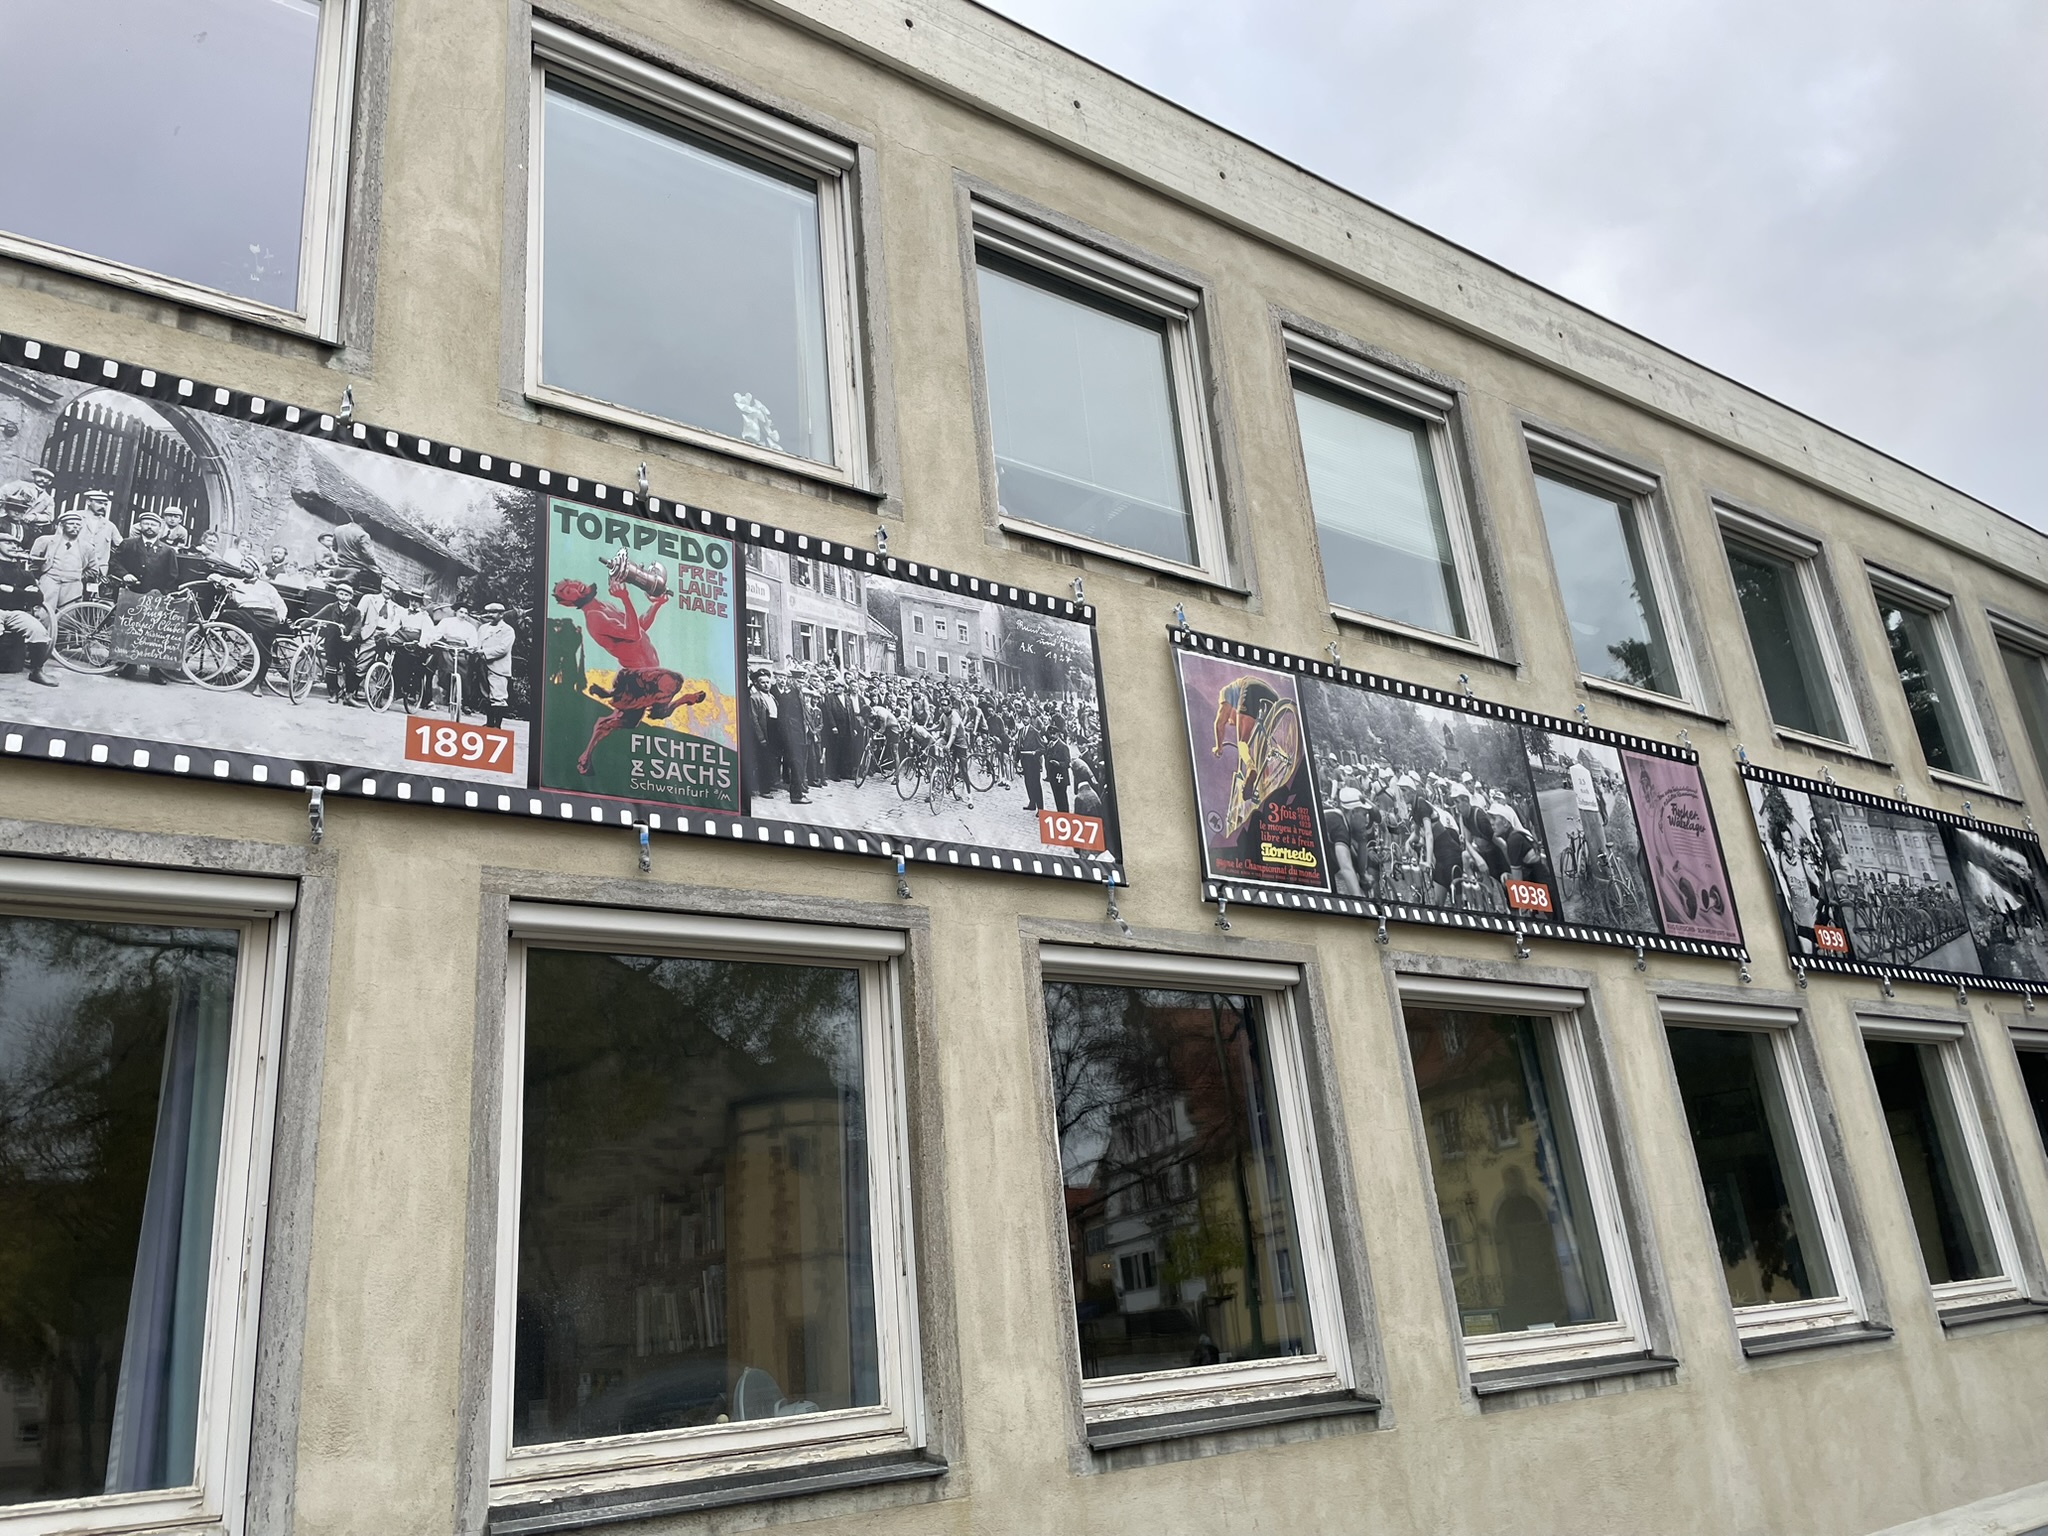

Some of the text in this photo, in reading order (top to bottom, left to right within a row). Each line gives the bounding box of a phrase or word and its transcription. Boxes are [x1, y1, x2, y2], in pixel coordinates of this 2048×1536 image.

[553, 504, 728, 570] TORPEDO
[678, 578, 728, 601] LAUF-
[678, 594, 728, 619] NABE
[415, 725, 508, 764] 1897
[631, 733, 731, 767] FICHTEL
[631, 758, 731, 788] & SACHS
[630, 778, 710, 799] Schweinfurt
[1268, 802, 1297, 823] 3 fois
[1044, 815, 1099, 845] 1927
[1259, 819, 1266, 830] le
[1267, 823, 1292, 835] moyeu
[1298, 827, 1313, 837] roue
[1261, 830, 1280, 843] libre
[1282, 834, 1290, 845] et
[1297, 835, 1315, 848] frein
[1260, 842, 1317, 866] Torpedo
[1235, 857, 1243, 869] le
[1244, 859, 1287, 875] Championnat
[1288, 864, 1298, 876] du
[1298, 867, 1320, 880] monde
[1510, 884, 1549, 908] 1938
[1818, 929, 1845, 948] 1939
